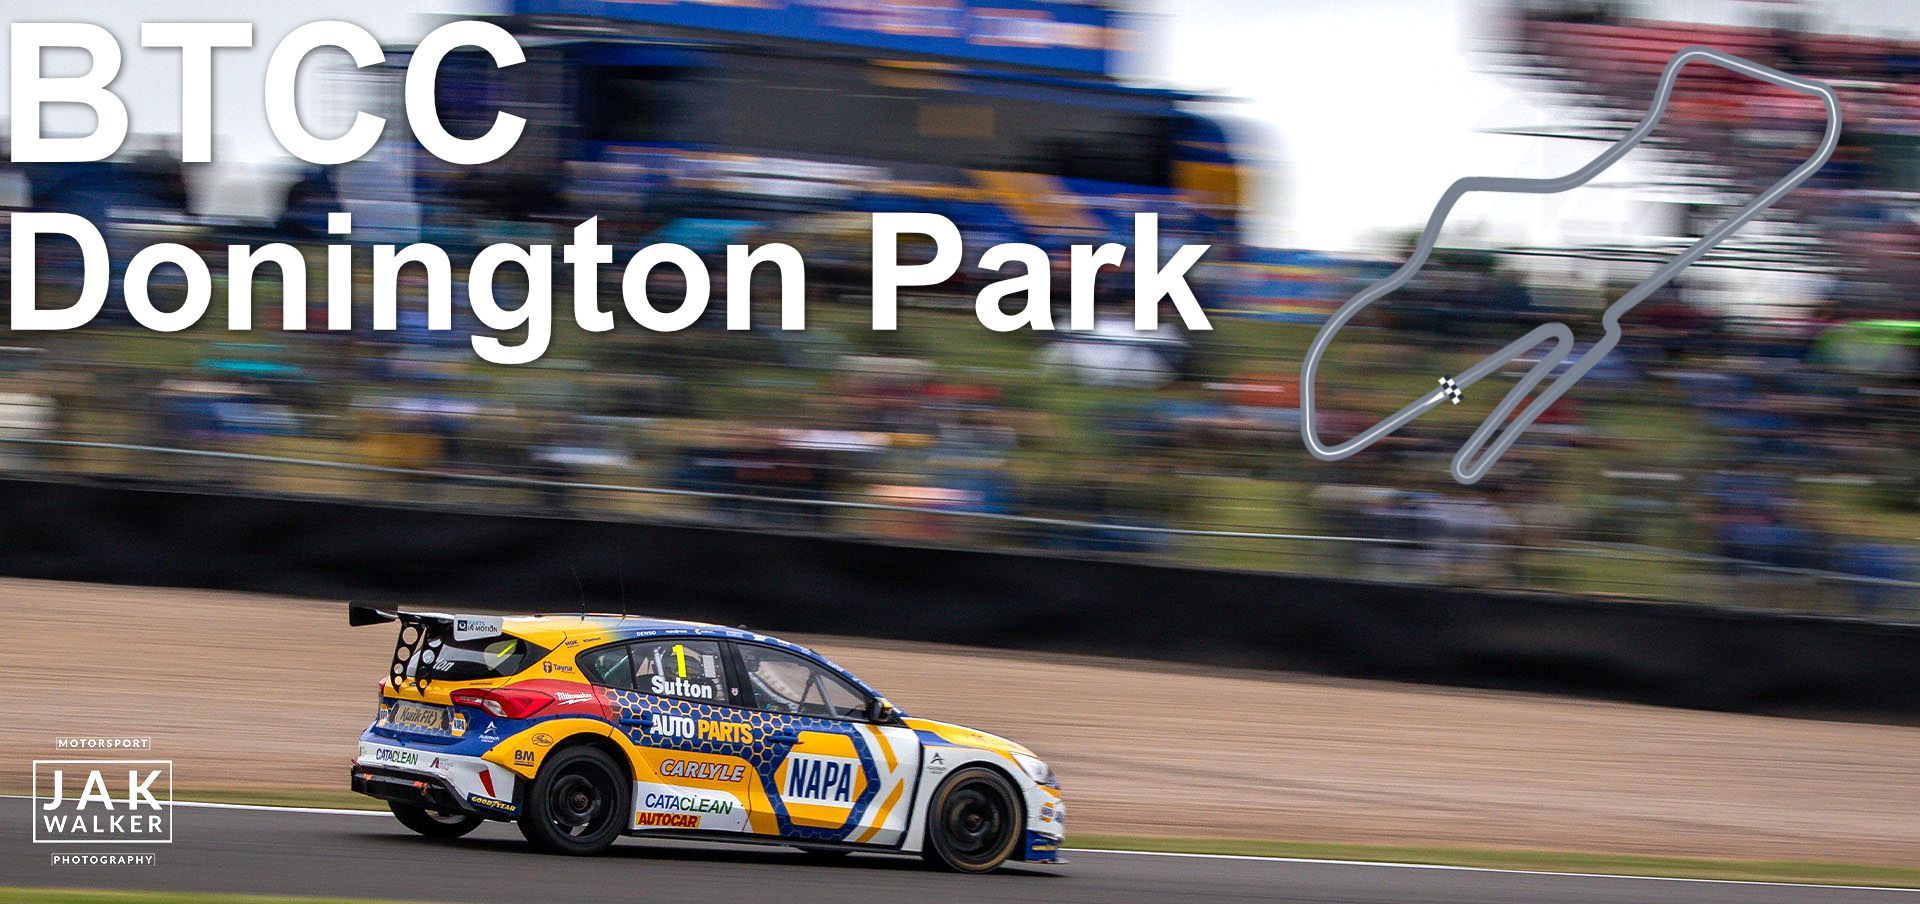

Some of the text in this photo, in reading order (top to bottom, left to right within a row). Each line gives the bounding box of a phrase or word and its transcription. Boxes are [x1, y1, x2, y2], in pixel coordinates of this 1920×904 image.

[553, 663, 573, 672] Tayna
[672, 644, 687, 678] 1
[651, 675, 713, 699] Sutton
[650, 714, 753, 745] AUTO PARTS
[375, 748, 418, 766] CATACLEAN
[514, 749, 535, 762] BM
[660, 759, 745, 783] CARLYLE
[789, 757, 852, 803] NAPA
[471, 796, 517, 812] GOODYEAR
[645, 793, 733, 815] CATACLEAN
[638, 812, 699, 828] AUTOCAR
